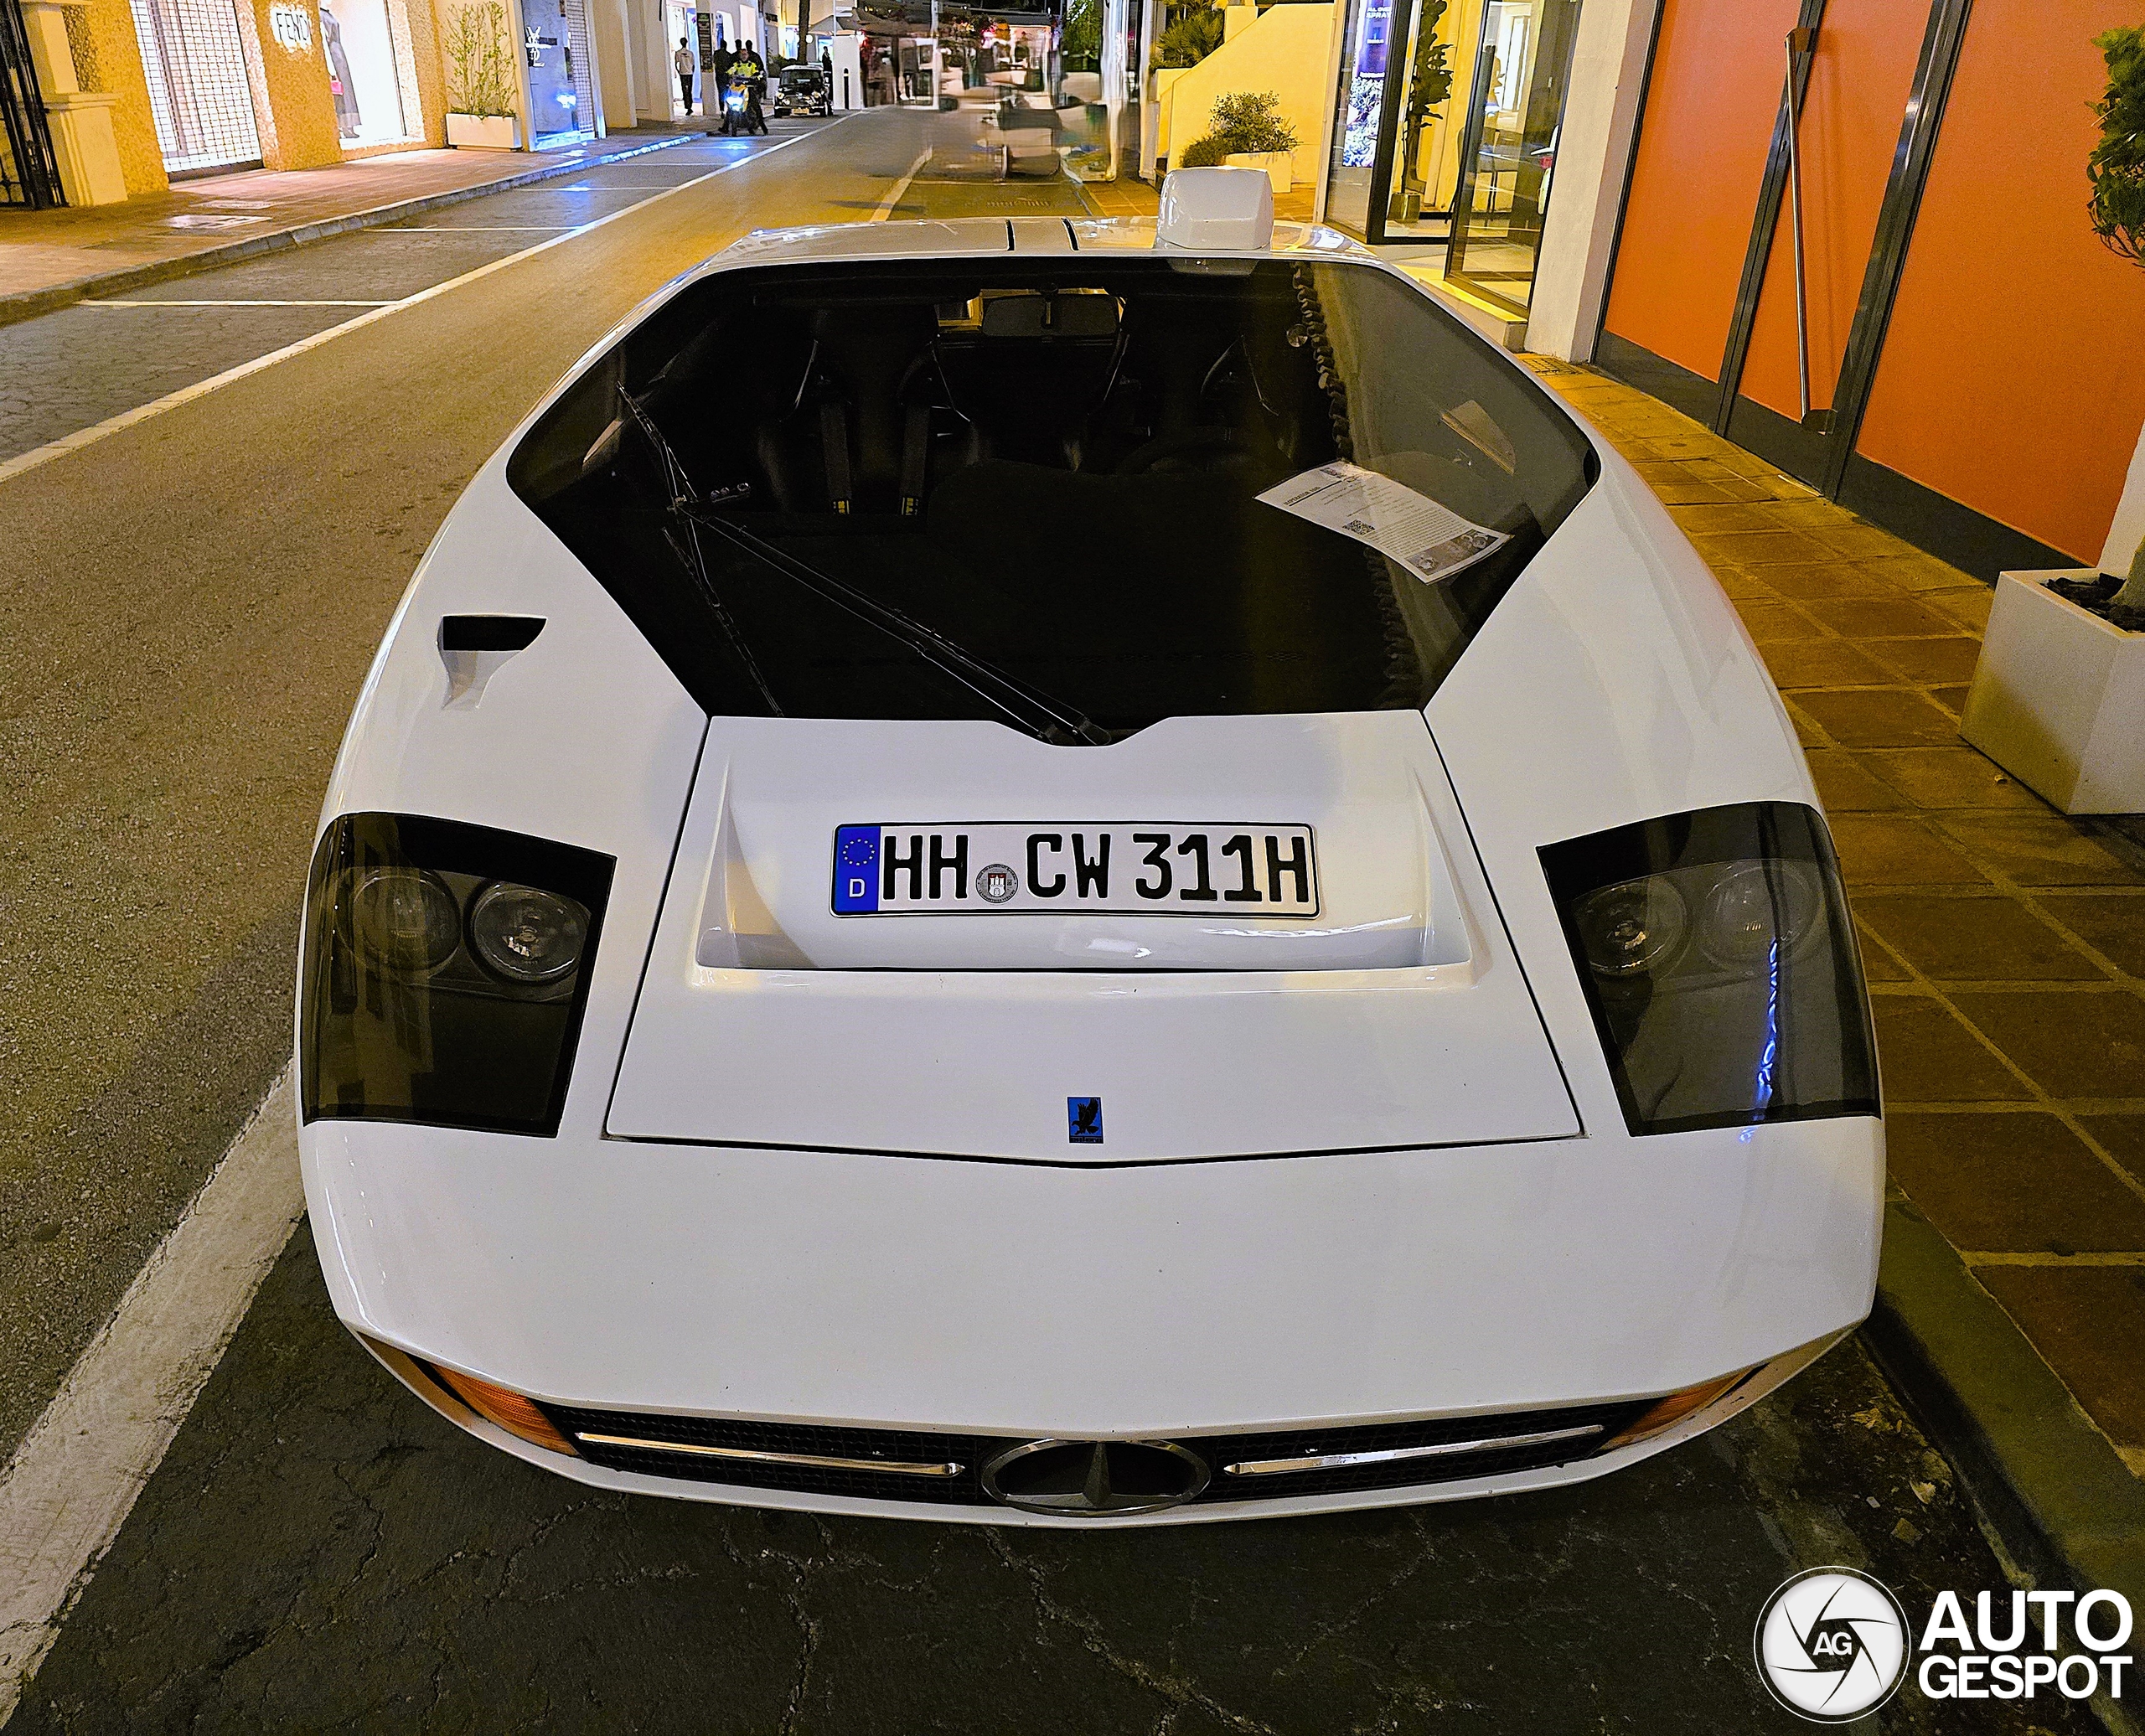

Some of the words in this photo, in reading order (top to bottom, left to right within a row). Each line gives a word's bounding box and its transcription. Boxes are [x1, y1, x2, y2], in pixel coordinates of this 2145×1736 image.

[848, 878, 866, 898] D
[882, 834, 969, 902] HH
[1026, 833, 1112, 899] CW
[1132, 834, 1310, 904] 311H
